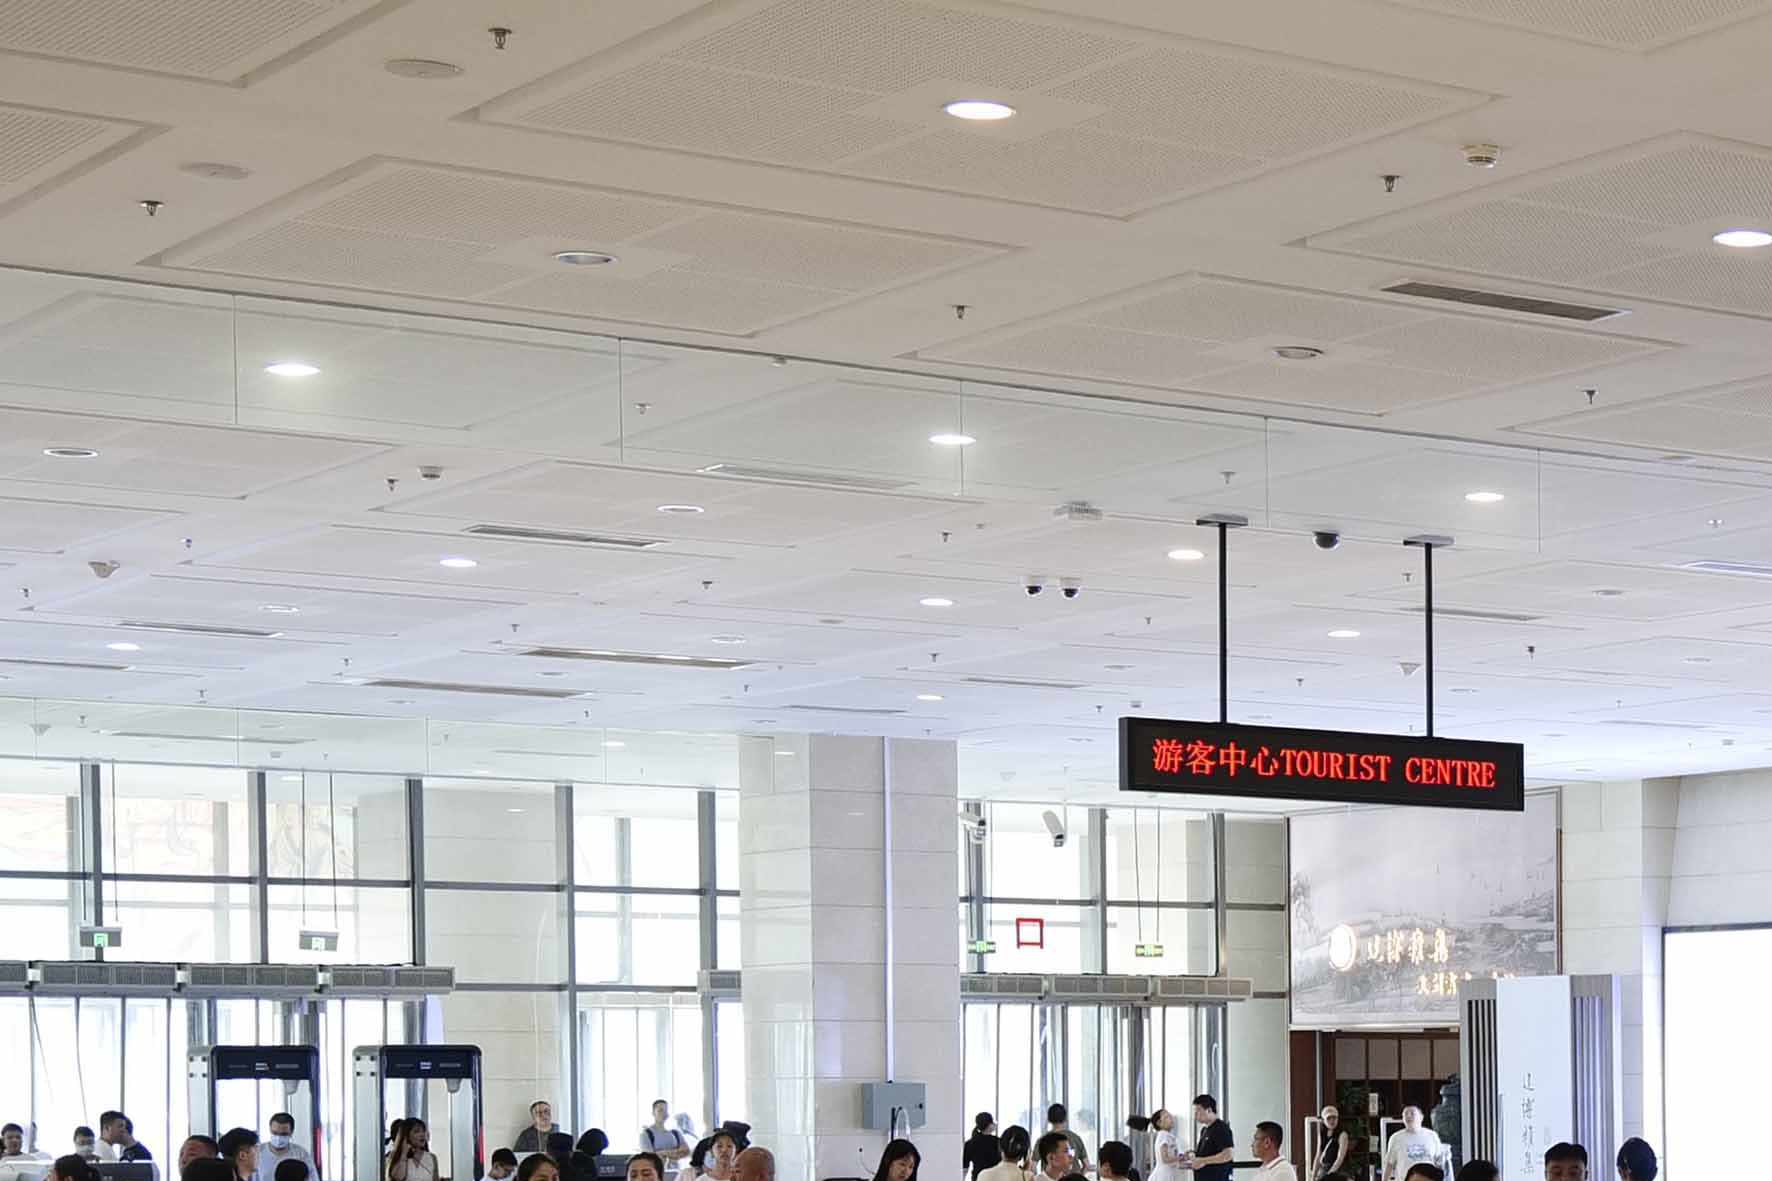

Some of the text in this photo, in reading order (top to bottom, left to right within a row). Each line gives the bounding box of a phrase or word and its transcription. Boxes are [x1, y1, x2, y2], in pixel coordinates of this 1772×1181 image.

[1152, 738, 1279, 778] 游客中心
[1280, 748, 1497, 789] TOURIST CENTRE
